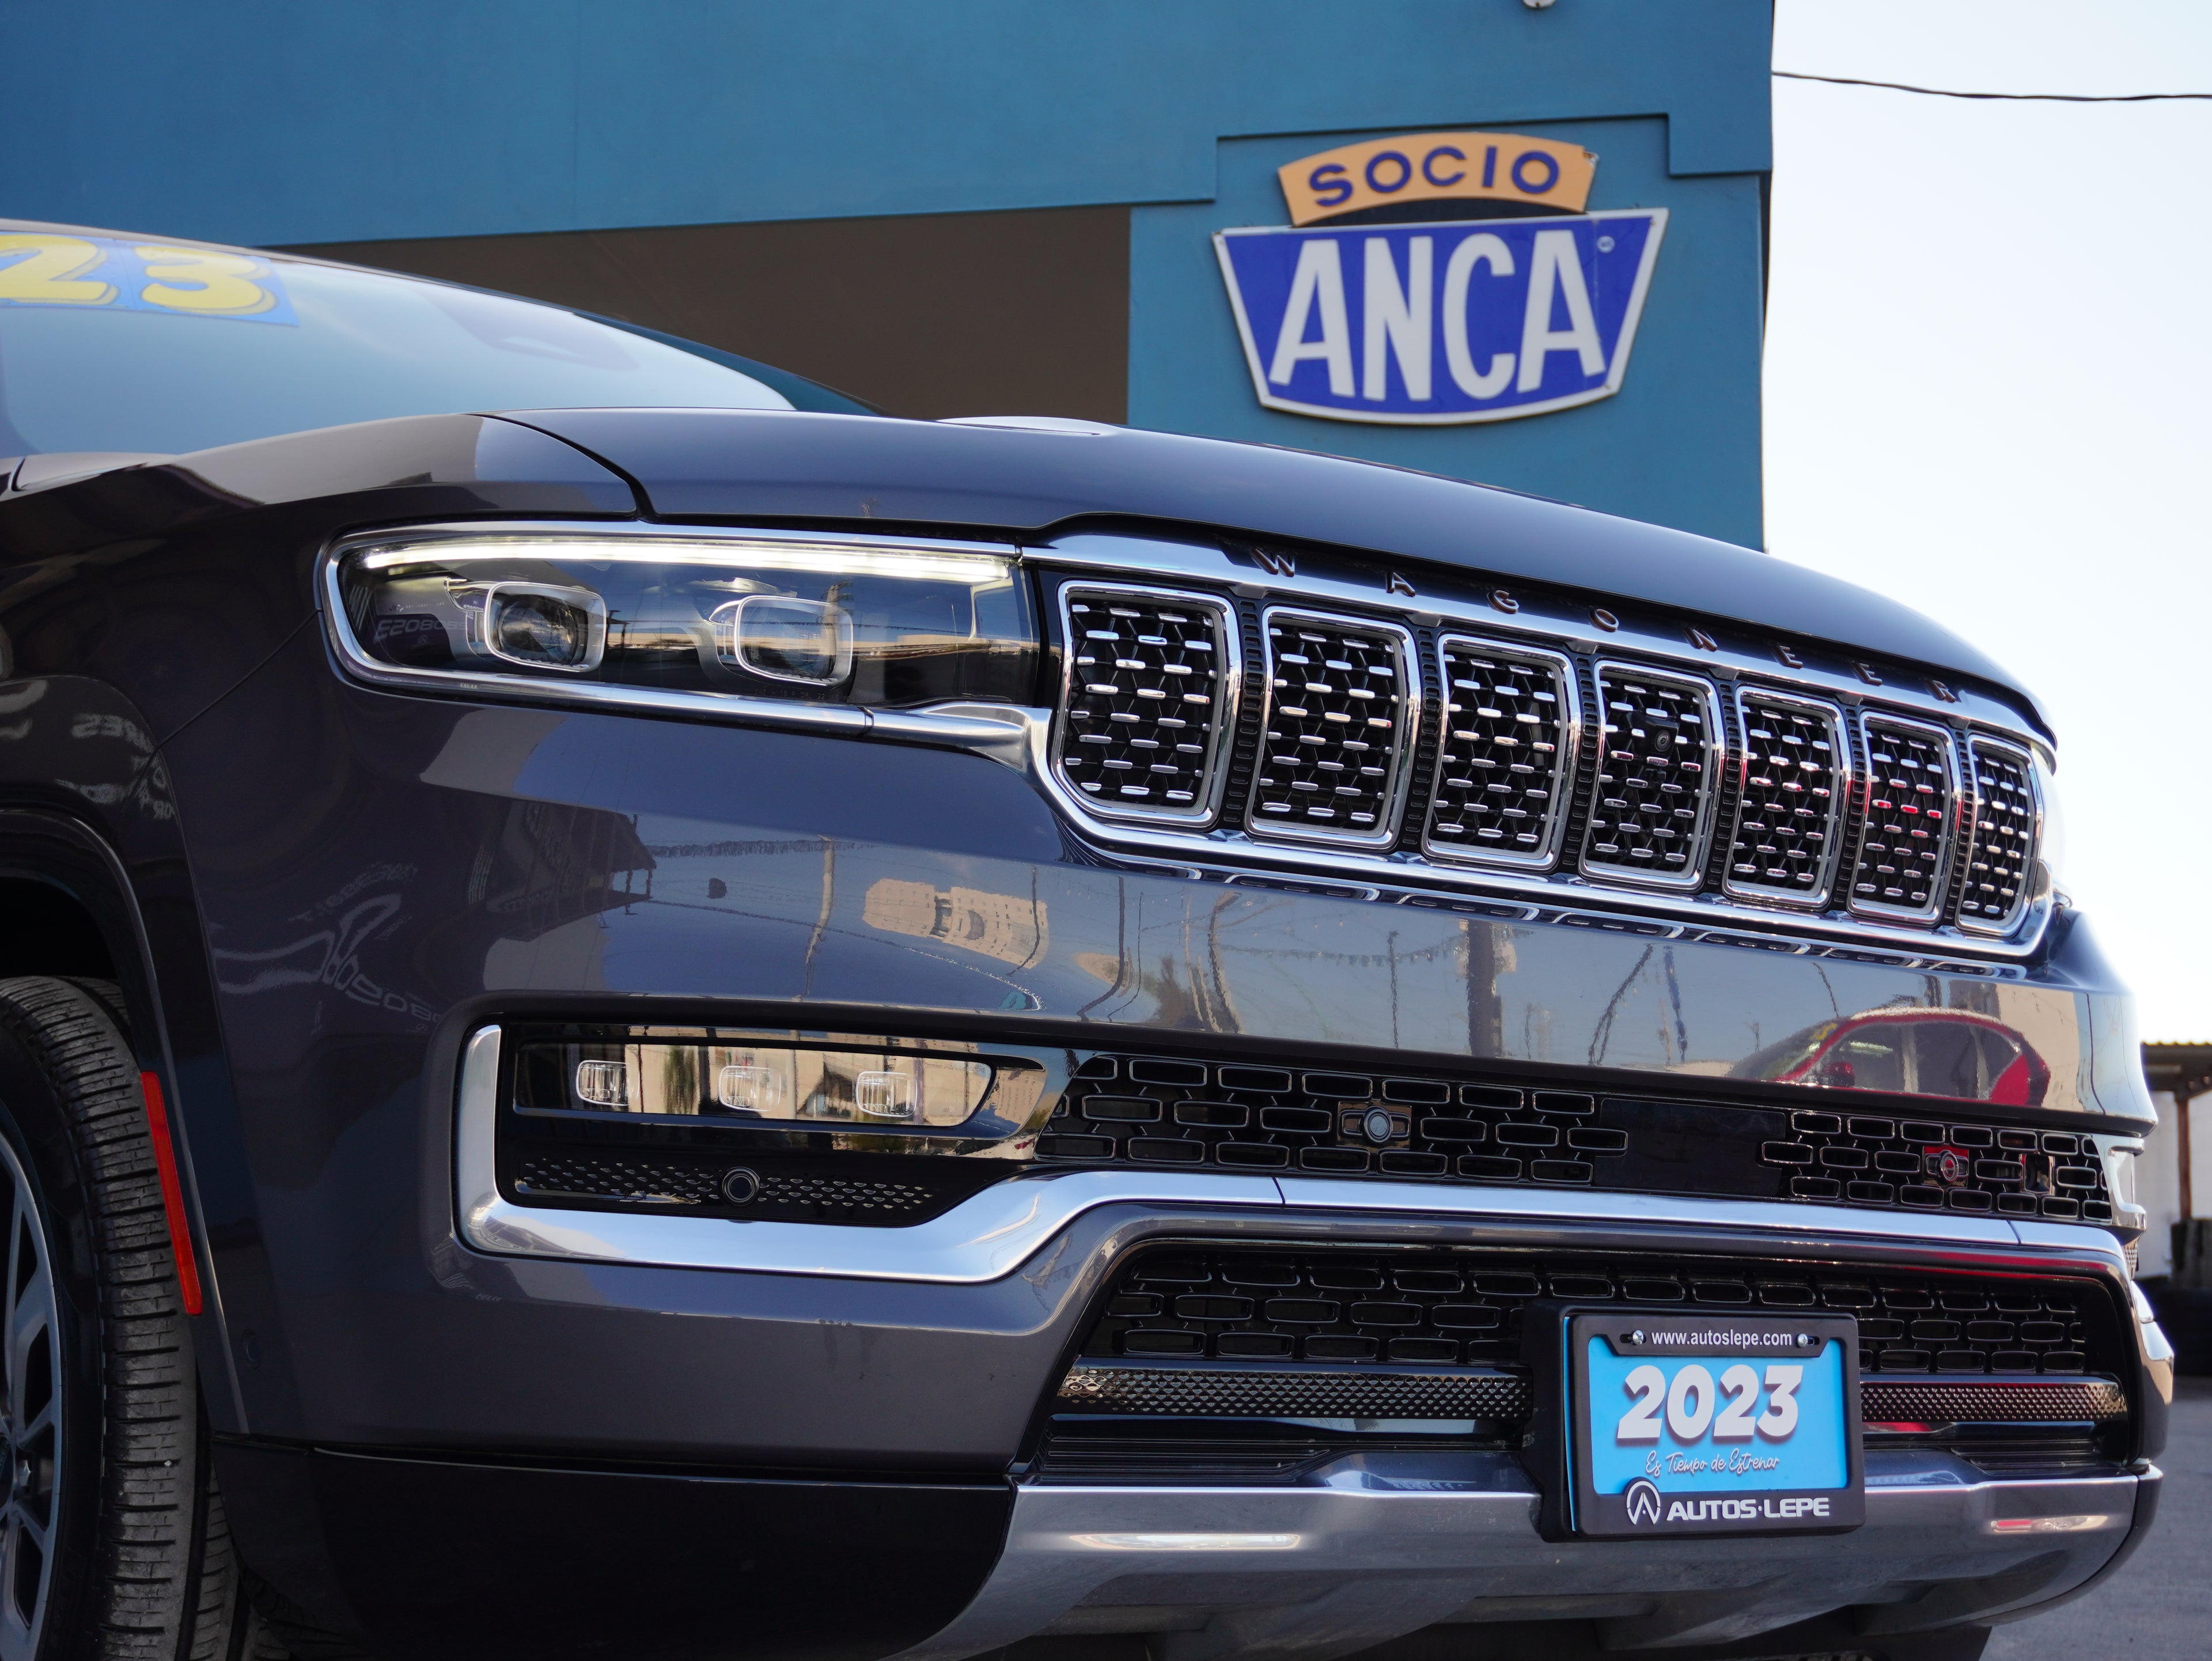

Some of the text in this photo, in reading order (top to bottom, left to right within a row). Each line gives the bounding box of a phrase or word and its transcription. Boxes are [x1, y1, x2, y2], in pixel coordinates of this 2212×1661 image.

[1309, 145, 1560, 207] SOCIO
[1269, 230, 1607, 402] ANCA
[1651, 1329, 1792, 1349] www.autoslepe.com
[1616, 1364, 1804, 1439] 2023
[1646, 1448, 1779, 1477] Es Tiempo de Estrenar
